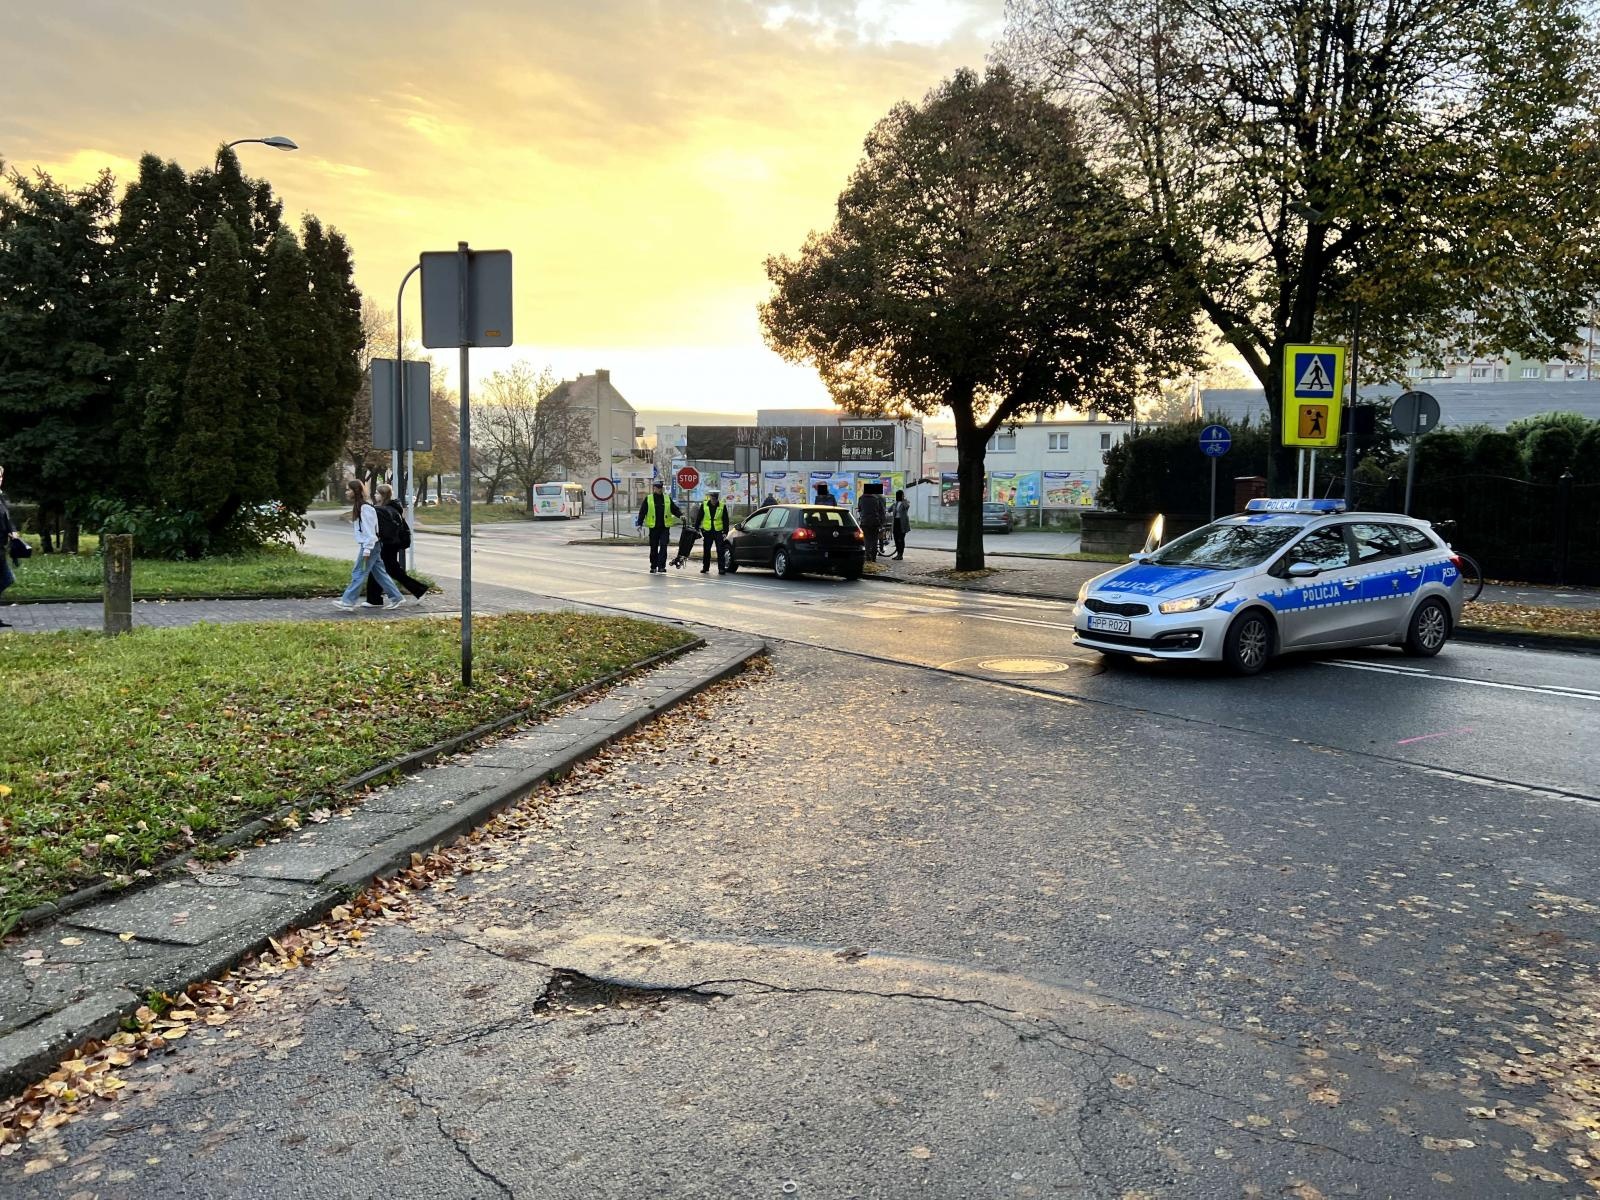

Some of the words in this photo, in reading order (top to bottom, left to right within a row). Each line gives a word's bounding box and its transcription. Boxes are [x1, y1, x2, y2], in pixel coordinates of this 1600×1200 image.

[679, 474, 698, 482] STOP
[1266, 500, 1296, 510] POLICJA
[1103, 580, 1161, 593] POLICJA
[1302, 585, 1341, 602] POLICJA
[1092, 618, 1107, 628] HPP
[1108, 620, 1129, 632] R022
